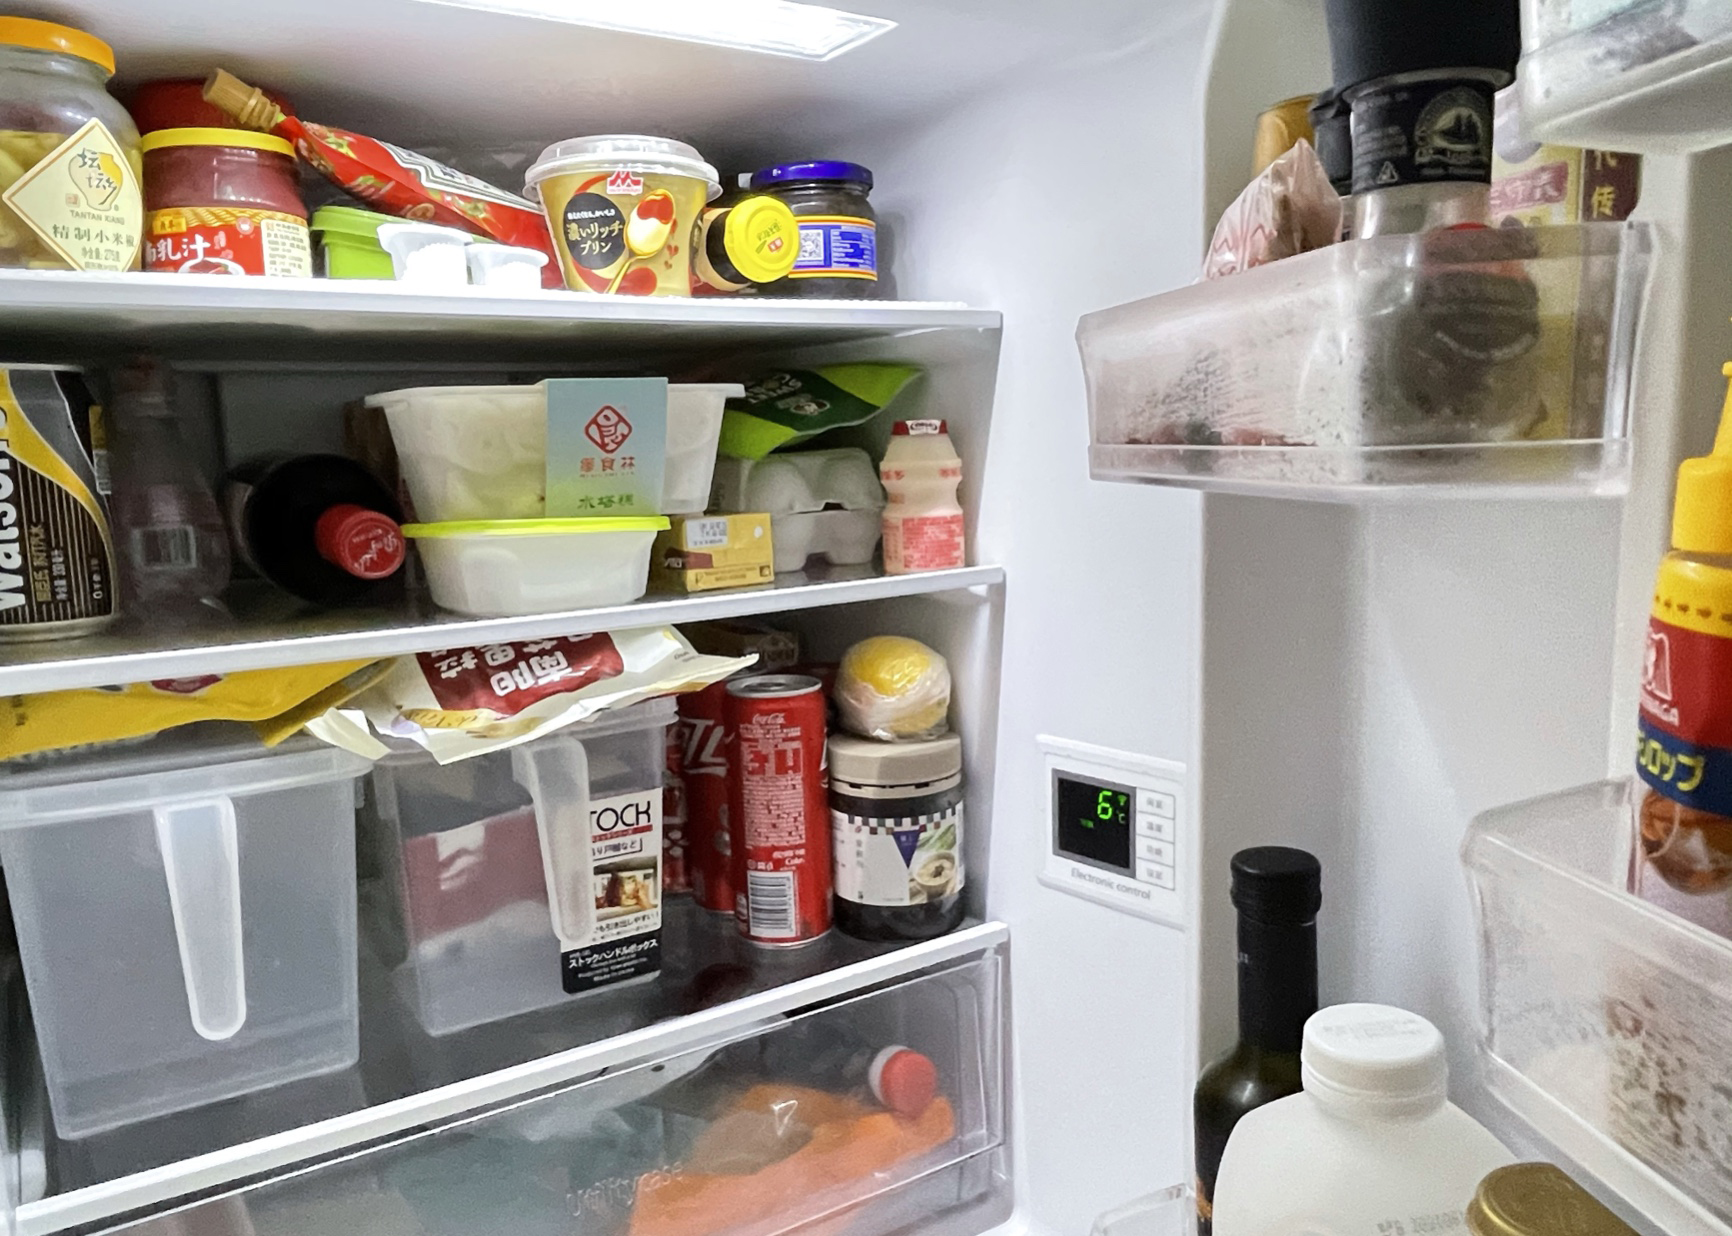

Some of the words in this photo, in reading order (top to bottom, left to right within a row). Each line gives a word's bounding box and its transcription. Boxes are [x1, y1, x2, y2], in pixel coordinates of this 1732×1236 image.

[70, 209, 102, 222] TANTAN
[104, 215, 125, 226] XIANG
[566, 220, 624, 242] 濃いリッチ
[52, 223, 135, 249] 精制小米椒
[580, 239, 612, 256] プリン
[490, 650, 572, 698] 南阳
[590, 799, 652, 833] OCK
[1097, 790, 1113, 820] 6
[1070, 867, 1115, 890] Electronic
[1115, 882, 1152, 901] control
